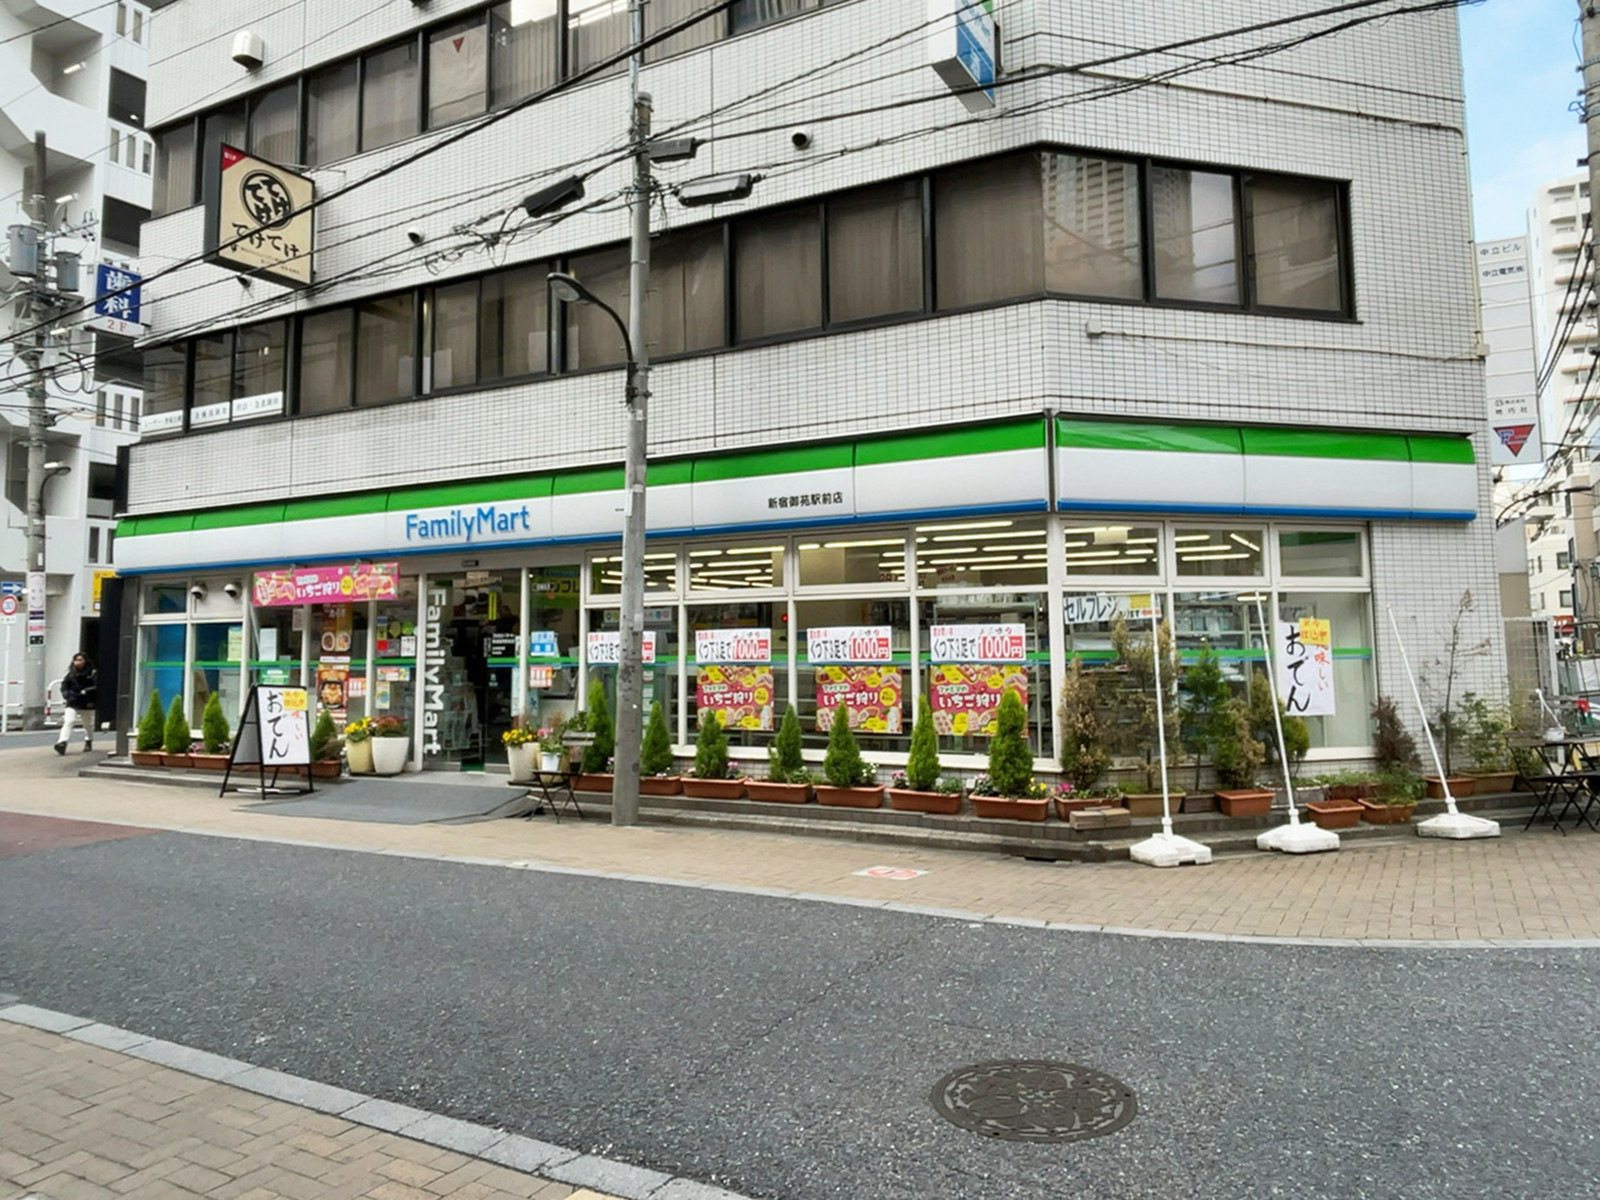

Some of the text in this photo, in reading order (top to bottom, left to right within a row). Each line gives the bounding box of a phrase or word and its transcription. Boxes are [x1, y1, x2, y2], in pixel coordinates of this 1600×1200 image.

[103, 269, 133, 319] 歯科
[768, 491, 843, 509] 新宿御苑駅前店
[406, 505, 531, 541] FamilyMart
[296, 582, 340, 598] いちご狩り
[1064, 596, 1118, 621] セルフレジ
[424, 588, 447, 755] FamilyMart
[1285, 625, 1310, 712] おでん
[703, 692, 753, 704] いちご狩り
[939, 694, 1001, 708] いちご狩り
[267, 690, 290, 759] おでん
